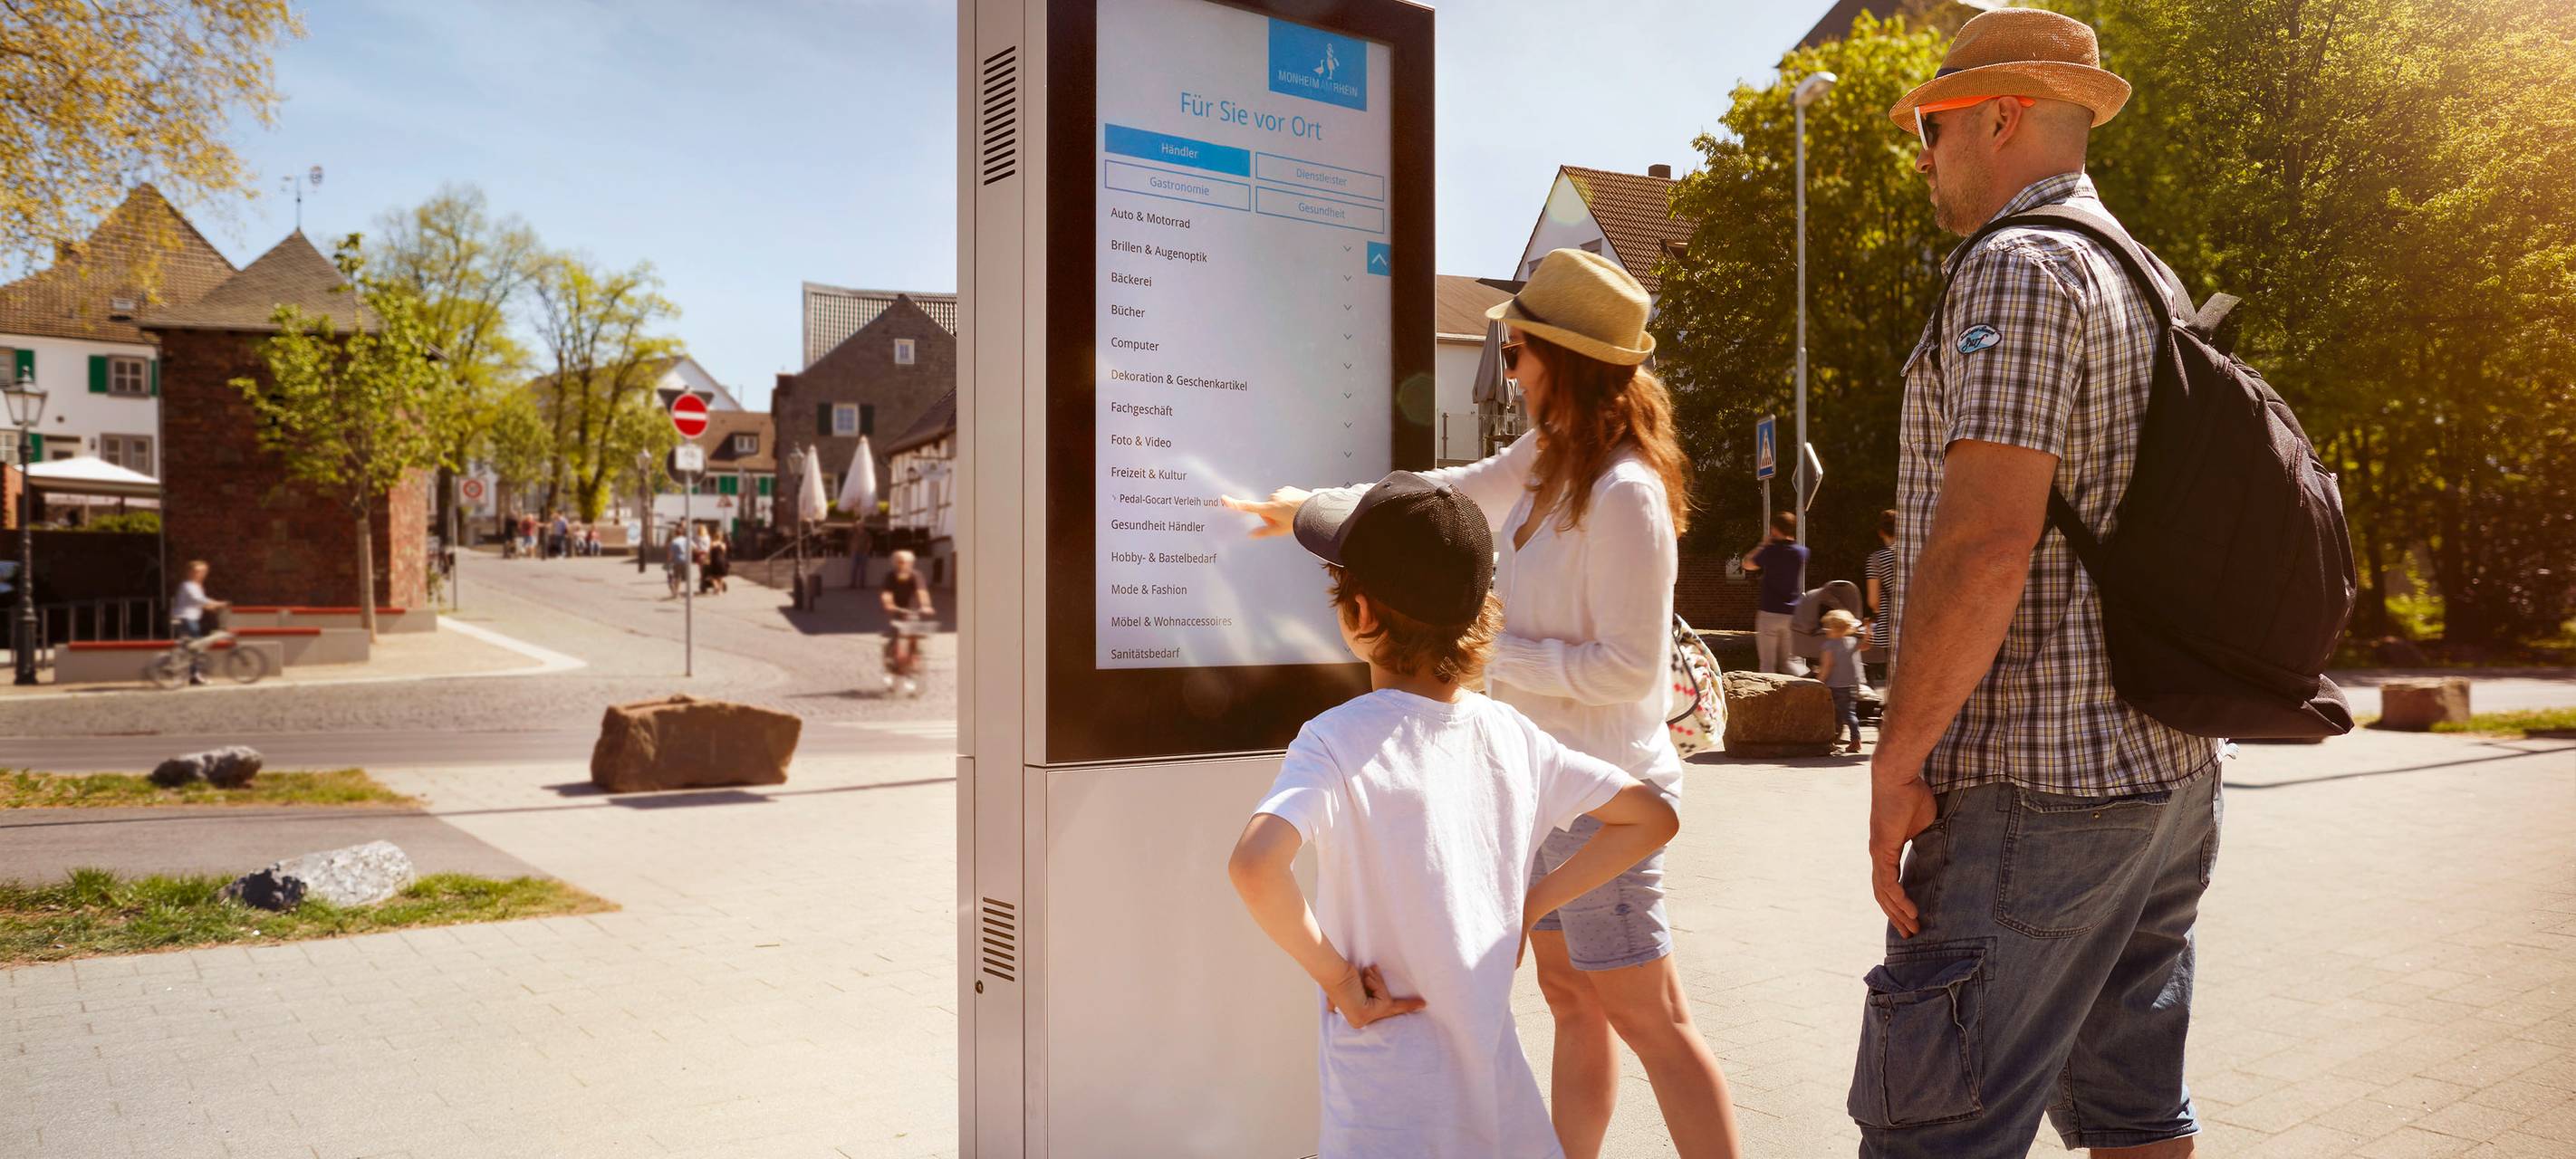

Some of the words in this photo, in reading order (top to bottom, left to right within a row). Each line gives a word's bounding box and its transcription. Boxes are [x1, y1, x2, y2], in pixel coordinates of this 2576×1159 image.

[1181, 91, 1214, 118] Für
[1219, 101, 1248, 125] Sie
[1254, 111, 1285, 132] vor
[1292, 116, 1322, 141] Ort
[1161, 143, 1198, 159] Händler
[1296, 168, 1348, 187] Dienstleister
[1149, 177, 1210, 196] Gastronomie
[1110, 207, 1134, 221] Auto
[1136, 211, 1145, 222] &
[1147, 213, 1191, 229] Motorrad
[1298, 201, 1346, 220] Gesundheit
[1110, 239, 1142, 254] Brillen
[1145, 244, 1153, 255] &
[1155, 245, 1208, 263] Augenoptik
[1110, 273, 1153, 288] Bäckerei
[1110, 304, 1146, 318] Bücher
[1110, 337, 1159, 352] Computer
[1110, 369, 1164, 385] Dekoration
[1166, 374, 1174, 385] &
[1176, 375, 1248, 391] Geschenkartikel
[1110, 401, 1174, 417] Fachgeschäft
[1110, 434, 1133, 447] Foto
[1135, 436, 1143, 446] &
[1144, 436, 1172, 449] Video
[1110, 466, 1147, 480] Freizeit
[1148, 468, 1157, 479] &
[1158, 468, 1187, 481] Kultur
[1120, 493, 1172, 506] Pedal-Gocart
[1173, 495, 1202, 506] Verleih
[1203, 498, 1219, 507] und
[1110, 519, 1166, 532] Gesundheit
[1168, 521, 1206, 532] Händler
[1110, 551, 1147, 566] Hobby-
[1148, 552, 1157, 563] &
[1158, 552, 1217, 565] Bastelbedarf
[1110, 583, 1139, 596] Mode
[1141, 584, 1149, 595] &
[1151, 584, 1187, 596] Fashion
[1110, 616, 1142, 627] Möbel
[1144, 617, 1152, 627] &
[1154, 616, 1233, 627] Wohnaccessoires
[1110, 647, 1181, 661] Sanitätsbedarf
